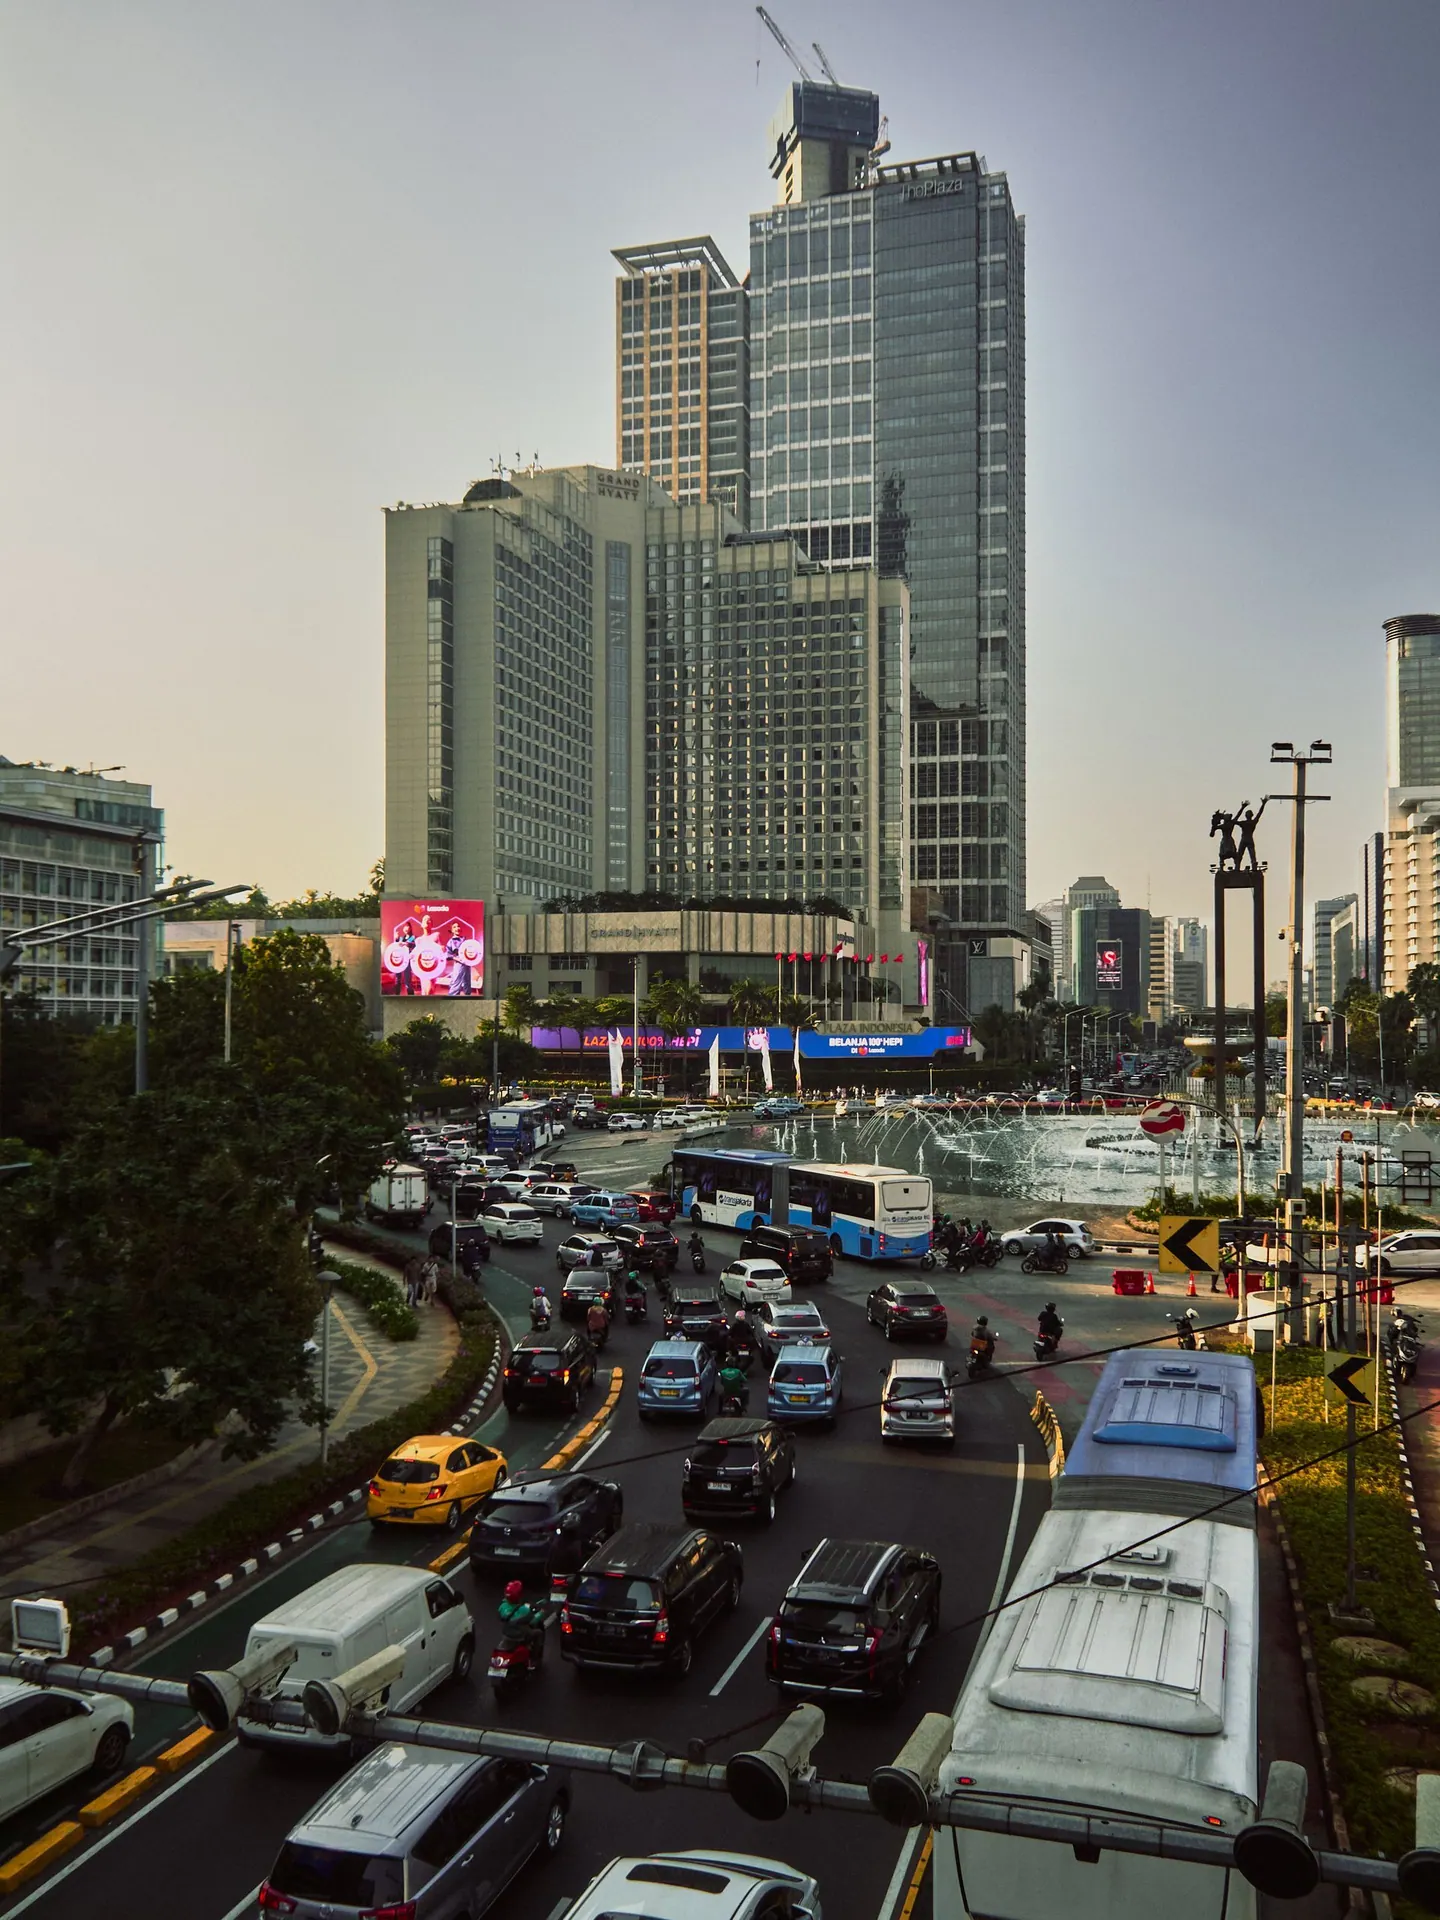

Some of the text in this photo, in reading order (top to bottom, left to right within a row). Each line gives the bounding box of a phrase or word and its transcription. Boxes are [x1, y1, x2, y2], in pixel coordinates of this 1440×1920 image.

[597, 473, 640, 488] GRAND
[598, 487, 638, 501] HYATT
[590, 927, 678, 938] GRAND HYATT
[823, 1023, 913, 1033] PLAZA INDONESIA
[829, 1037, 868, 1047] BELANJA
[885, 1037, 903, 1046] HEPI
